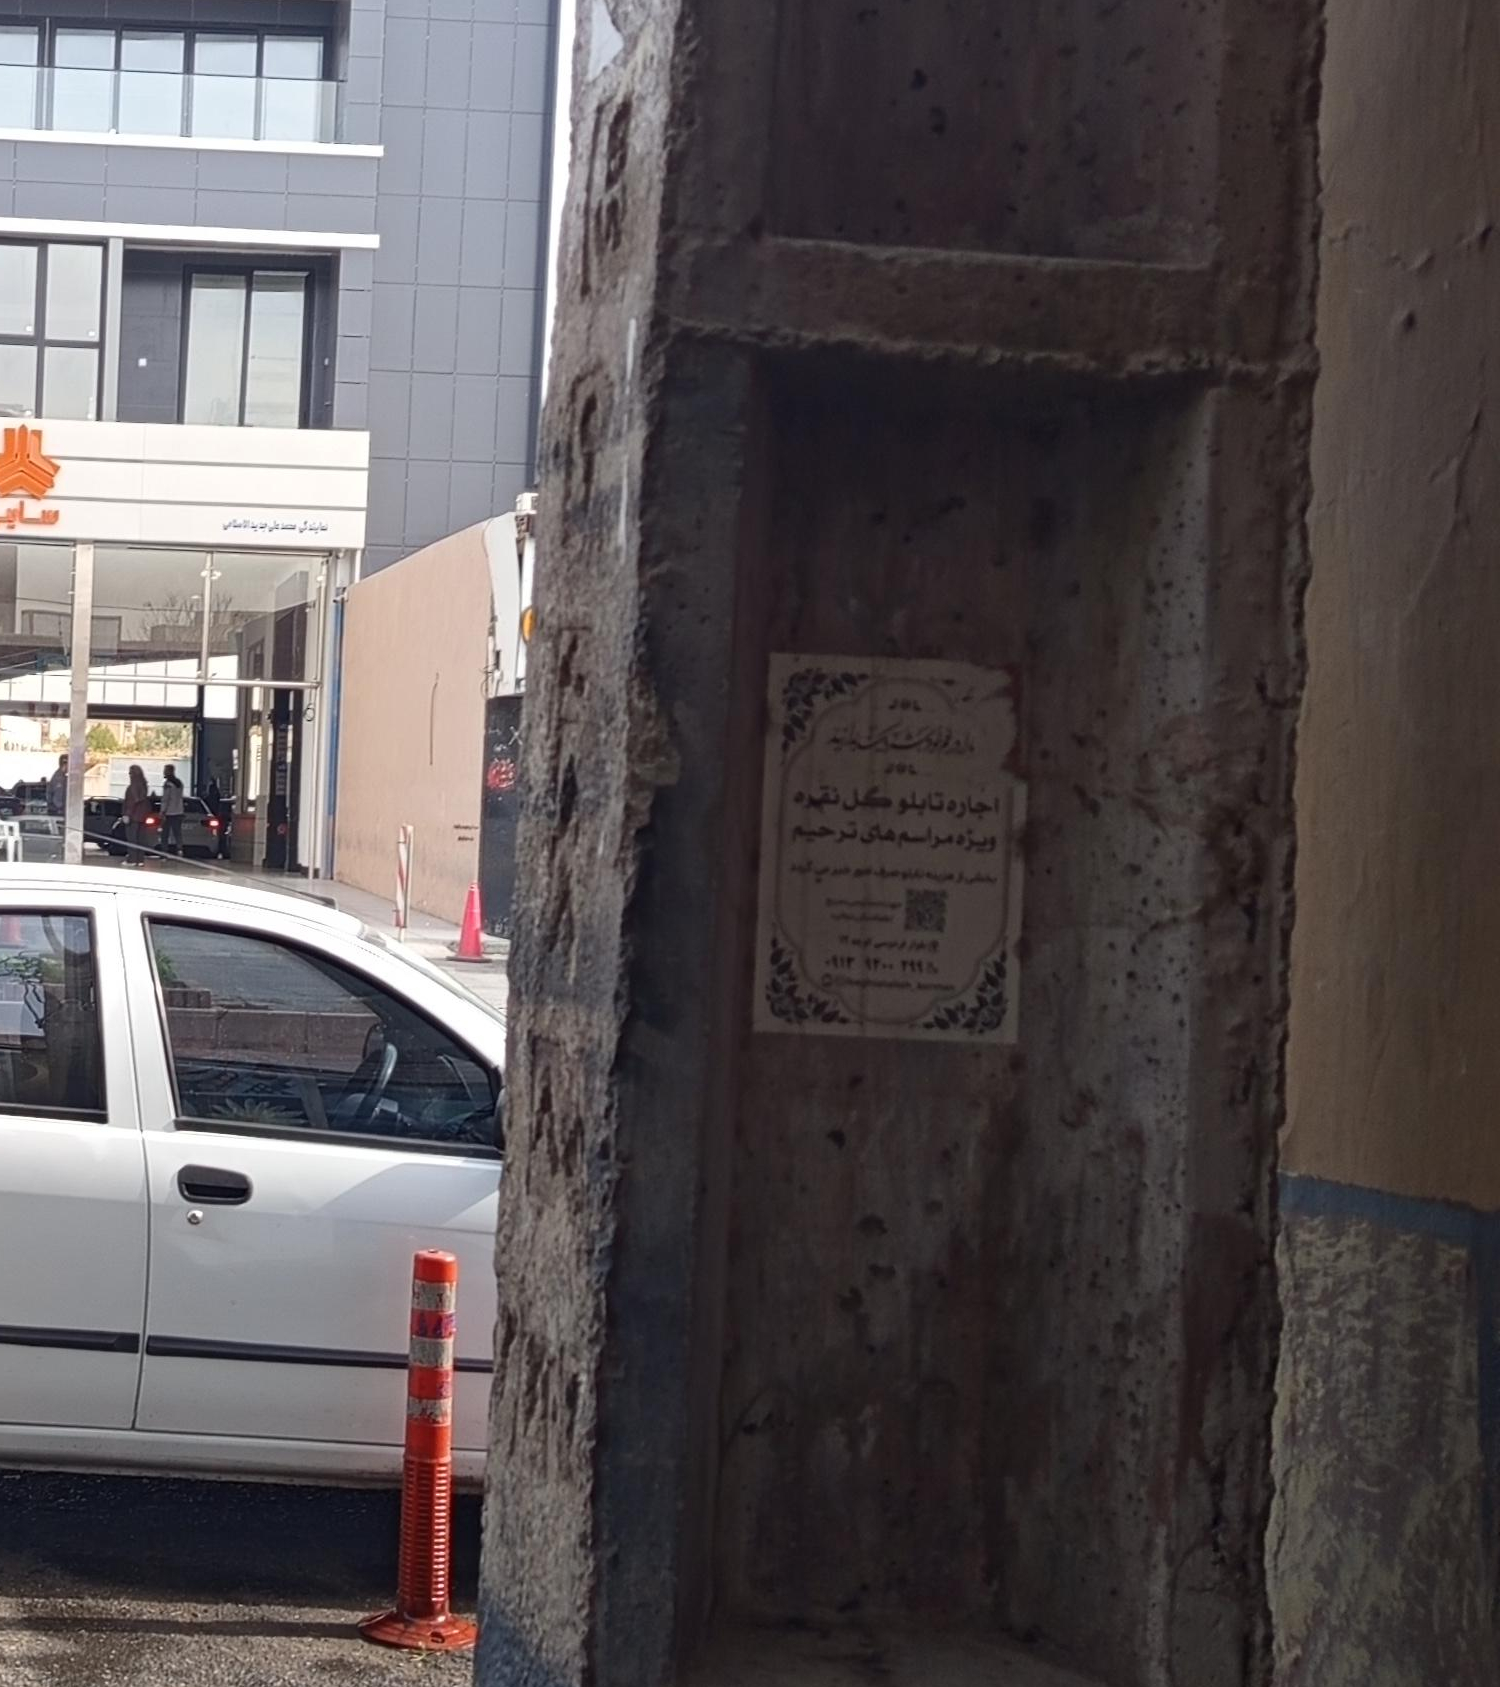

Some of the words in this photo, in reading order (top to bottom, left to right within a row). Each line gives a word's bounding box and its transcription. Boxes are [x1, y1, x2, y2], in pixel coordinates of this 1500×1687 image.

[898, 790, 945, 815] تابلو
[946, 795, 1000, 818] اجاره
[791, 820, 858, 843] ترحیم
[956, 828, 996, 853] ویژه
